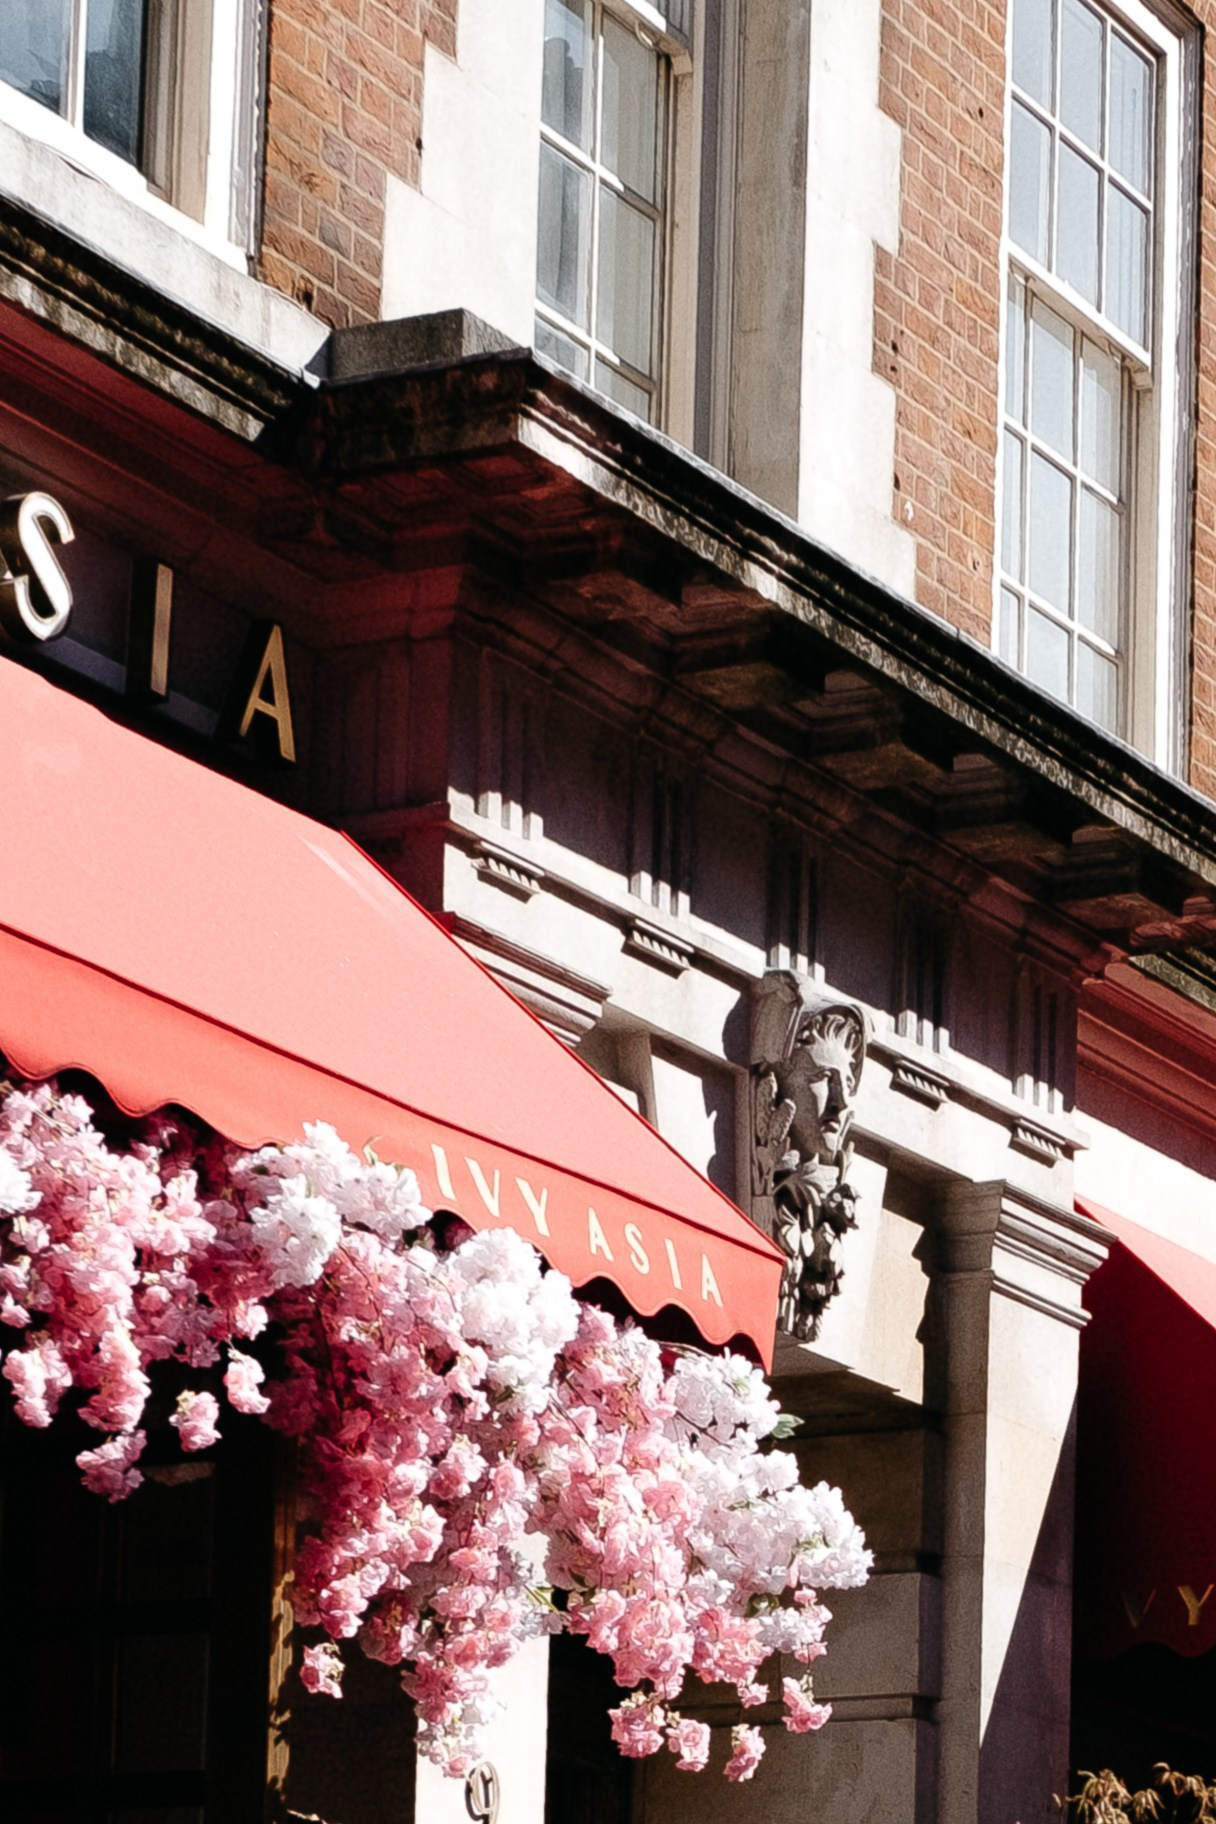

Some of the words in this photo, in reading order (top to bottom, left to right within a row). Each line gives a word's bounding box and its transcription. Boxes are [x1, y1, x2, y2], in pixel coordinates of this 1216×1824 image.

[0, 491, 296, 763] SIA
[430, 1143, 550, 1237] IVY
[587, 1207, 724, 1308] ASIA
